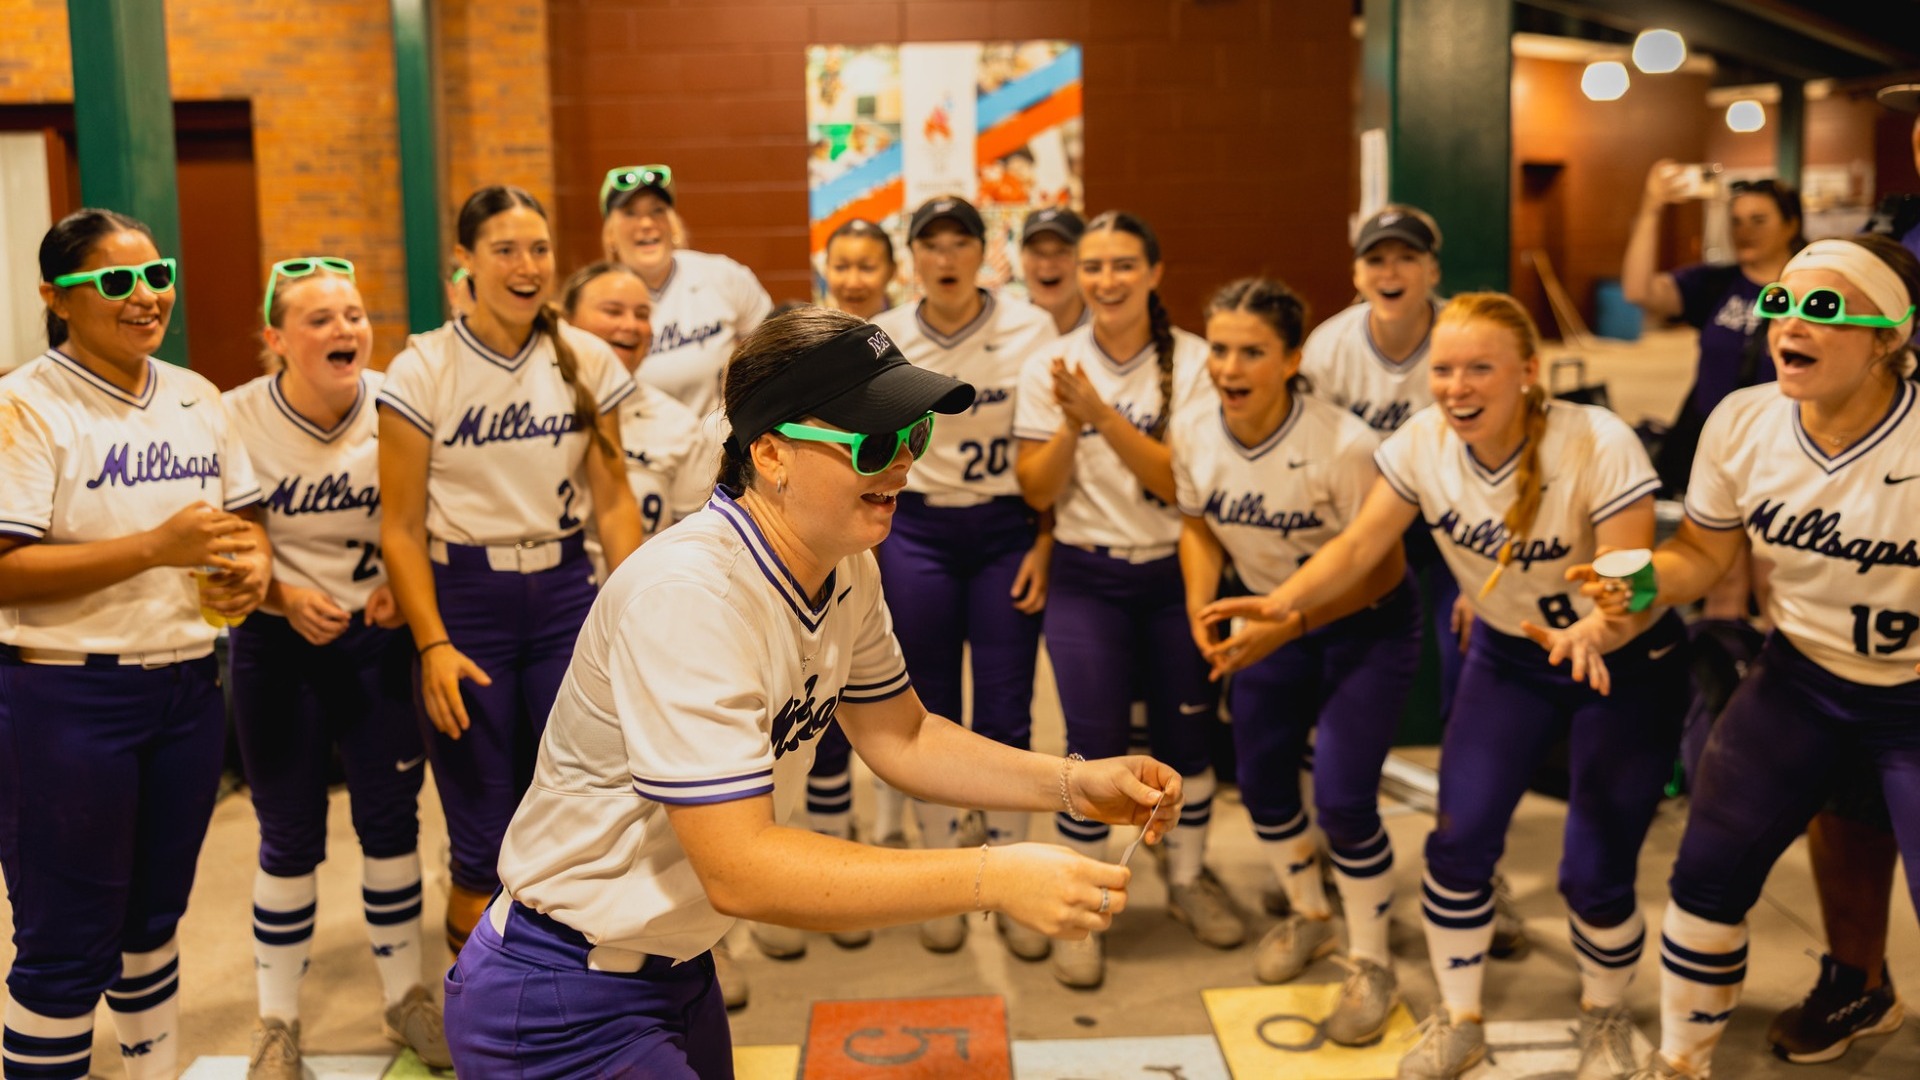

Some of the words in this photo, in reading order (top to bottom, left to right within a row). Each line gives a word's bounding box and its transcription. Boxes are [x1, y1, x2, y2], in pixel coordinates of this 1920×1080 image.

[443, 401, 583, 447] Millsap
[86, 441, 220, 489] Millsaps
[960, 437, 1009, 481] 20
[258, 472, 380, 517] Millsa
[557, 479, 580, 530] 2
[1205, 489, 1324, 538] Millsaps
[346, 539, 382, 582] 2
[1428, 509, 1571, 572] Millaps
[1747, 499, 1920, 574] Millsaps
[1851, 604, 1920, 657] 19
